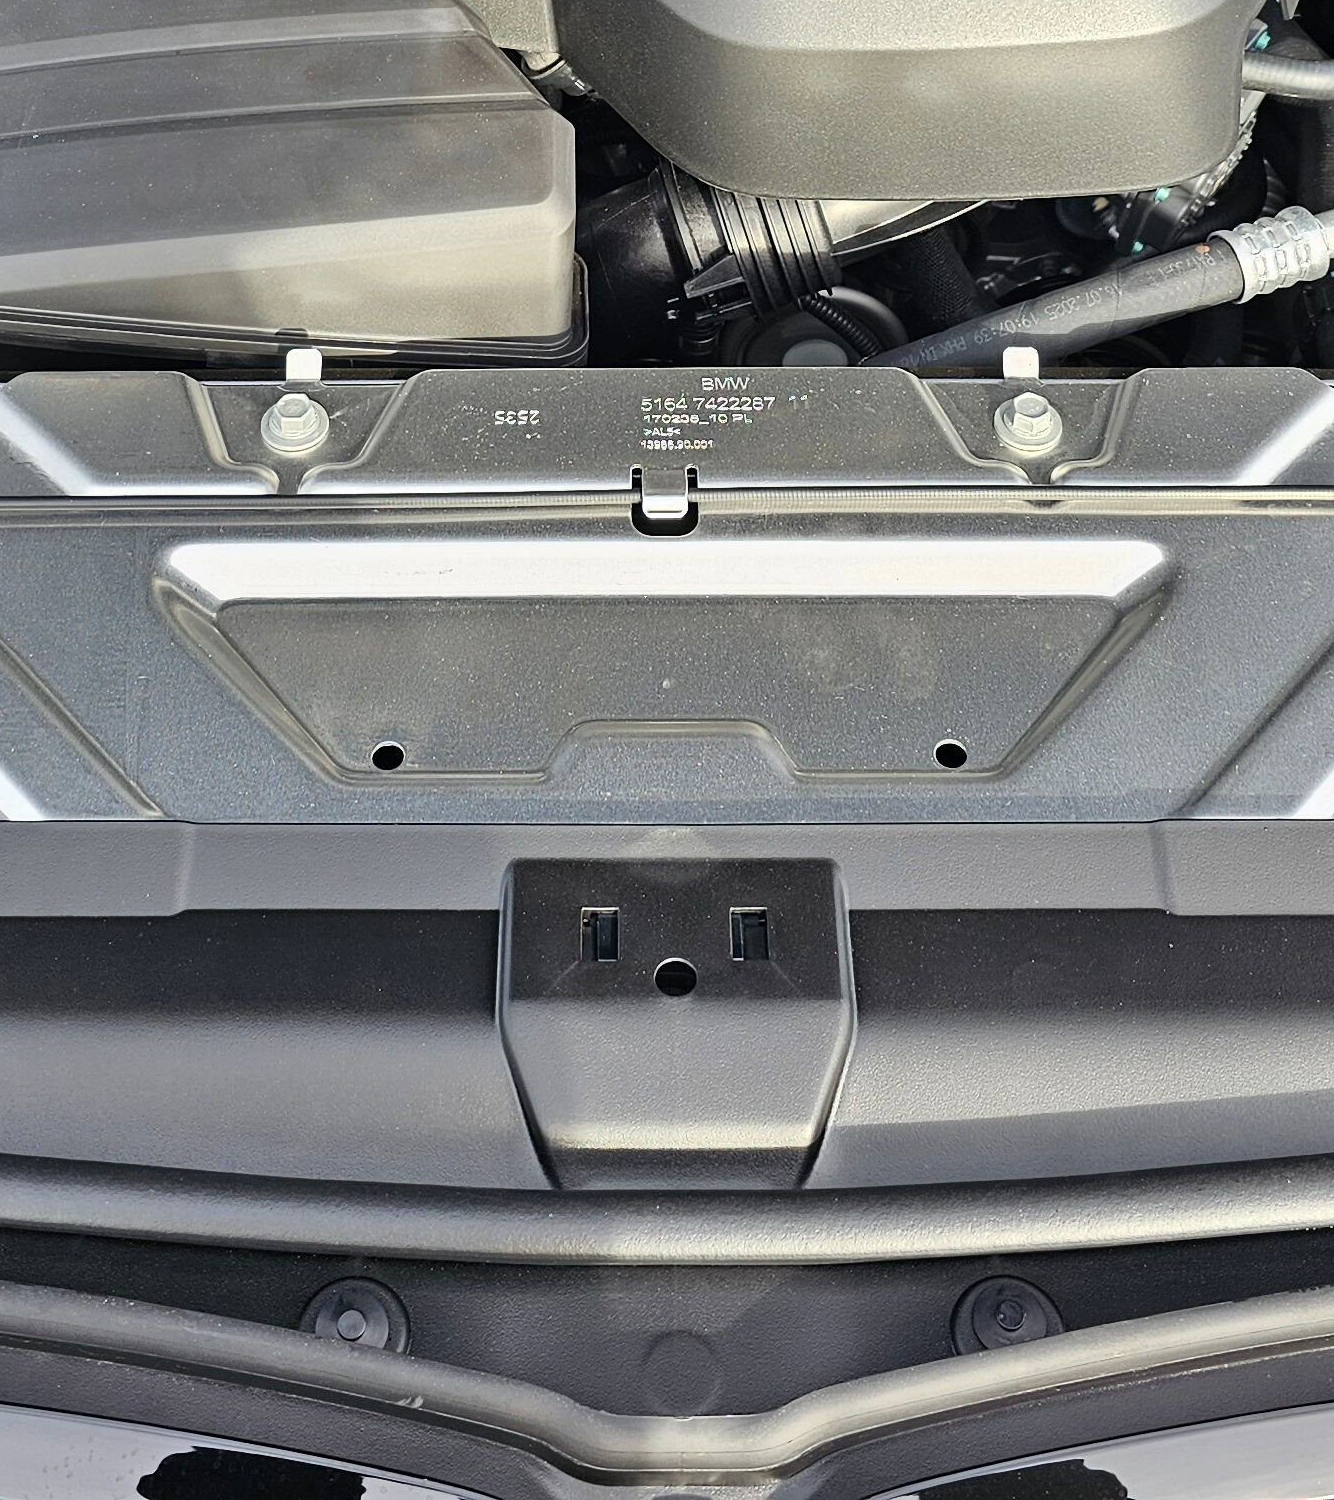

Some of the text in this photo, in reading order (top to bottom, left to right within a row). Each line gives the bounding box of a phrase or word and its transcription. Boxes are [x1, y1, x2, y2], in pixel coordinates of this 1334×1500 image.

[701, 377, 750, 391] BMW
[641, 397, 688, 411] 5164
[693, 396, 776, 411] 7422287
[495, 410, 540, 425] 2535
